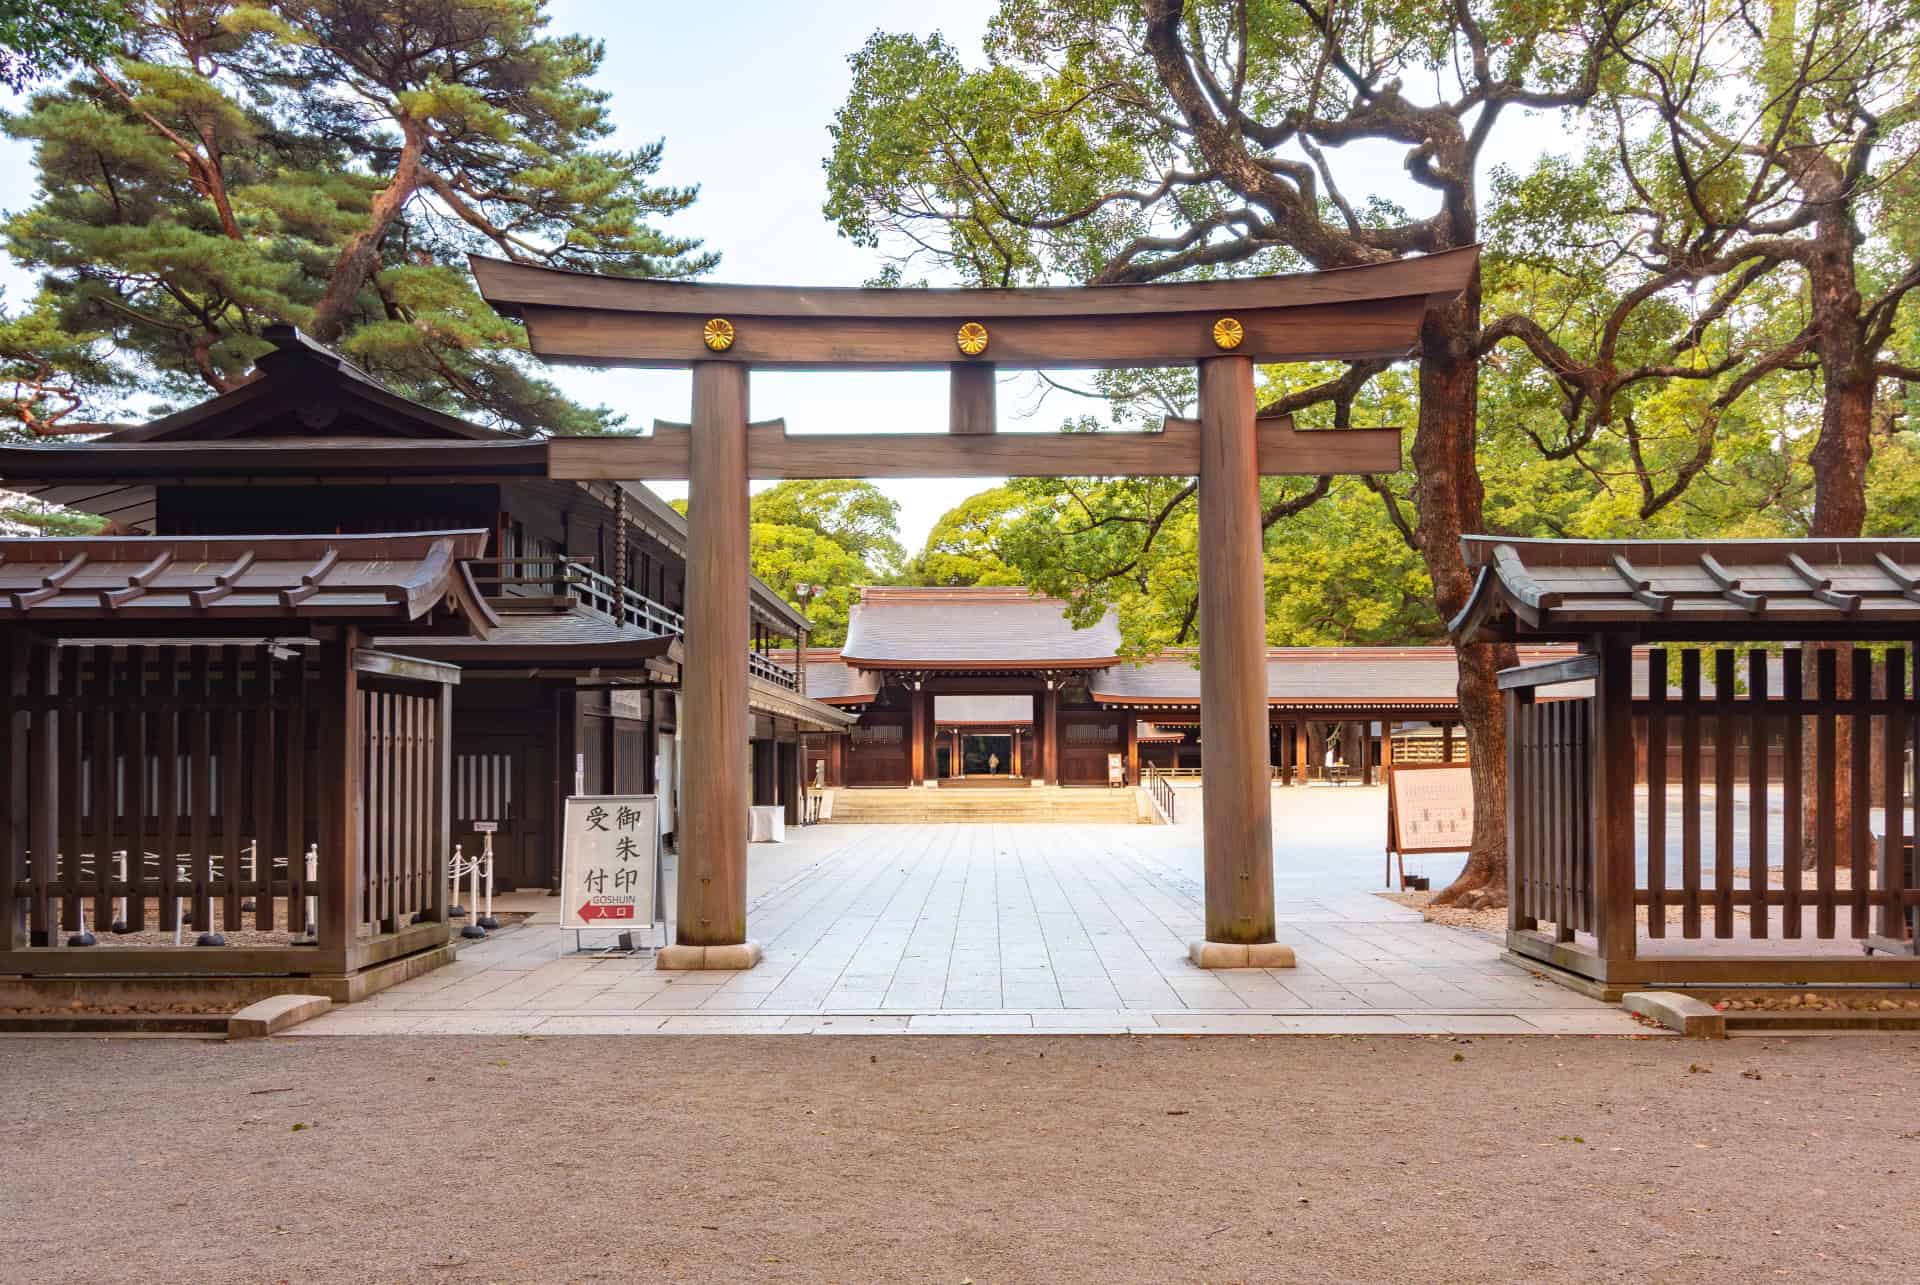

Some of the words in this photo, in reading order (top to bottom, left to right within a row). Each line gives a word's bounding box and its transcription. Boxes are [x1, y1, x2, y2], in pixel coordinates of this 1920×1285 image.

[584, 806, 610, 894] 受付
[615, 806, 641, 894] 御朱印
[592, 895, 636, 904] GOSHUIN
[597, 906, 626, 917] 入口
